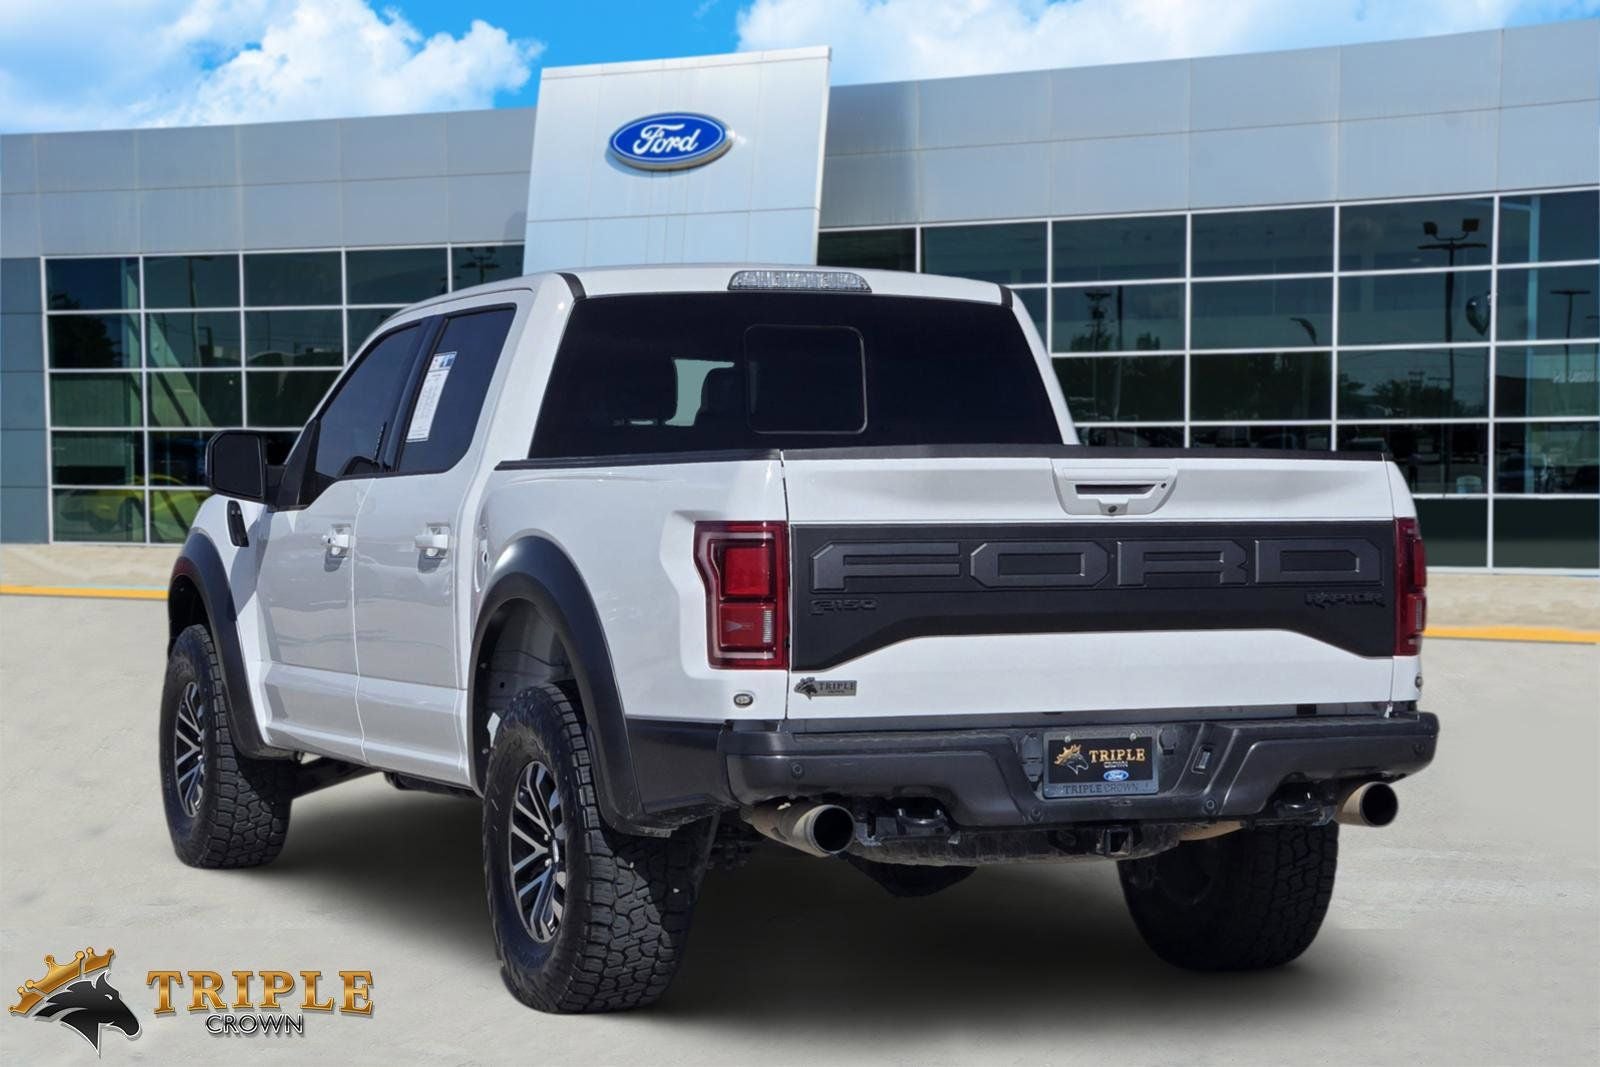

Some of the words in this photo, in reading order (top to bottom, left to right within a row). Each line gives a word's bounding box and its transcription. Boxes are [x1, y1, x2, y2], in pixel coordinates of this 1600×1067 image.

[632, 123, 701, 155] Ford
[811, 538, 1383, 591] FORD
[819, 681, 856, 690] TRIPLE
[1088, 748, 1146, 763] TRIPLE
[1063, 784, 1102, 795] TRIPLE
